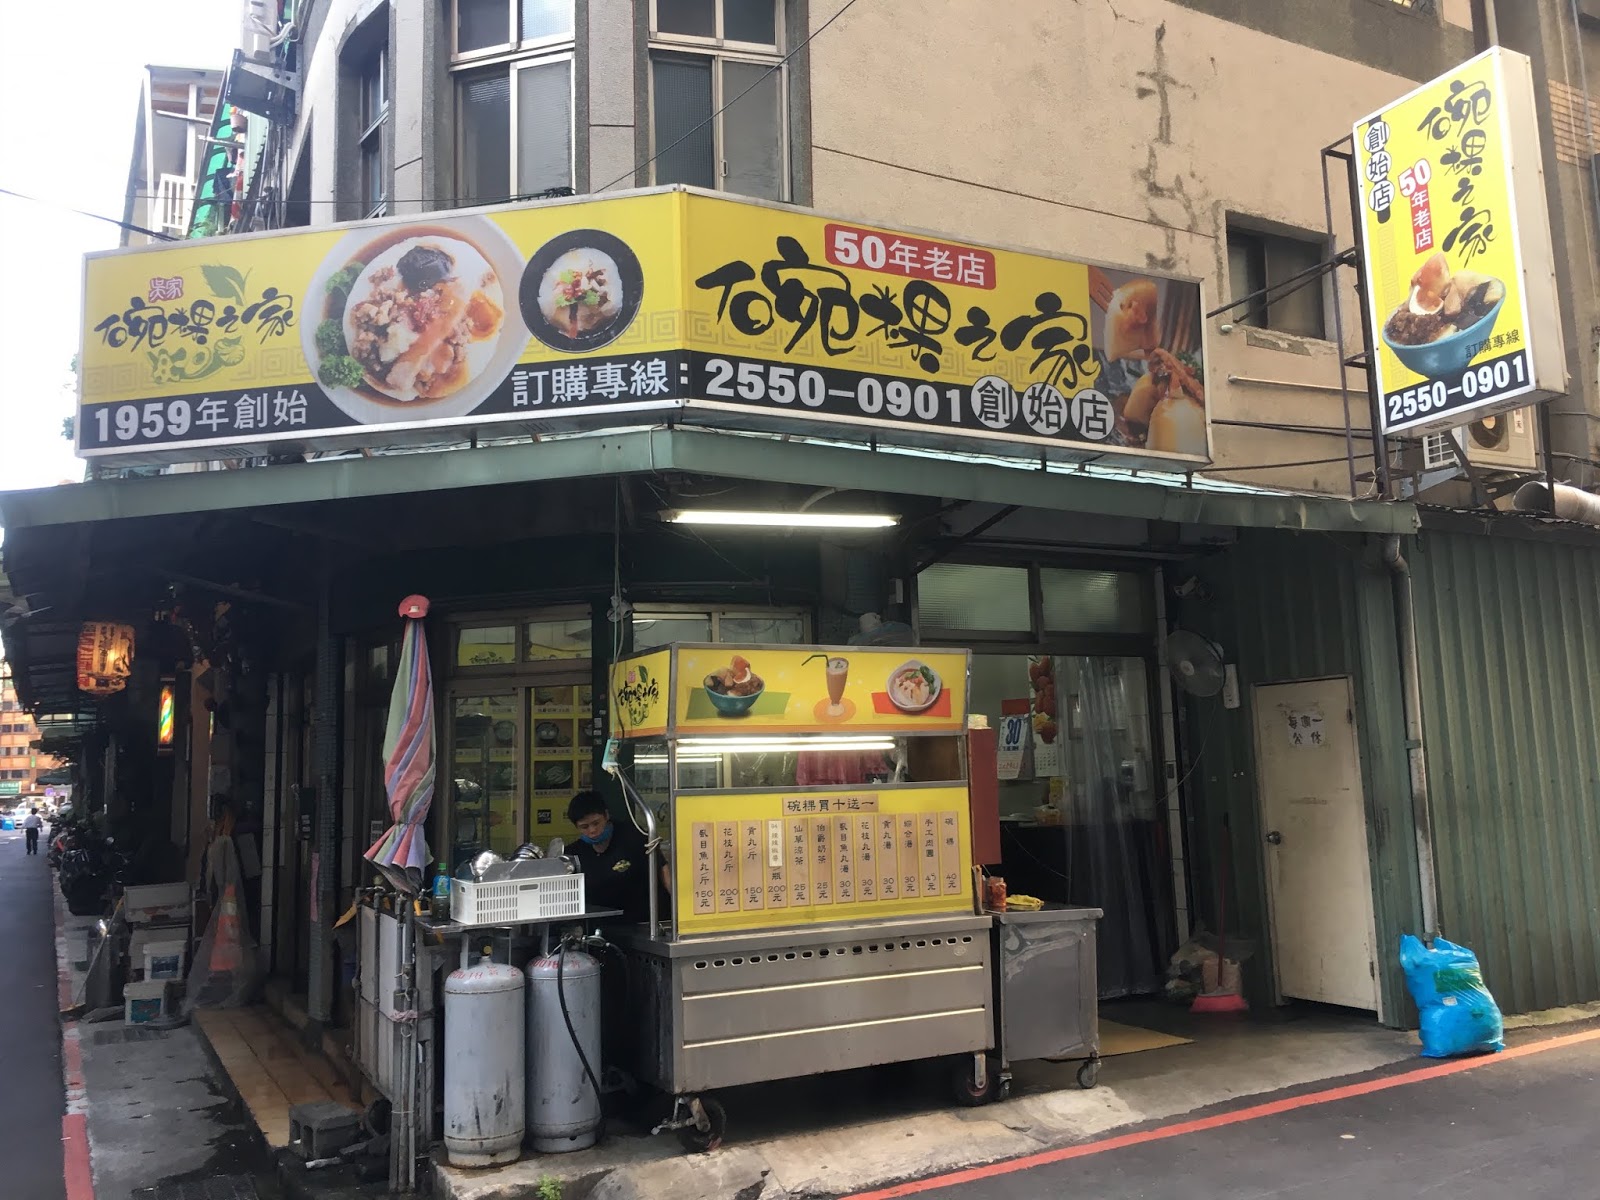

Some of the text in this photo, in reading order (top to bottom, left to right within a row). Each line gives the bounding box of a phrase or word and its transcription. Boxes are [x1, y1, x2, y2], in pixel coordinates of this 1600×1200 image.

[1365, 121, 1394, 211] 創始店
[1399, 158, 1432, 249] 50年老店
[833, 229, 987, 286] 50年老店
[1465, 329, 1520, 359] 訂購專線
[94, 390, 308, 443] 1959年創始
[705, 357, 962, 423] 2550-0901
[970, 375, 1115, 441] 創始店
[1388, 355, 1525, 421] 2550-0901
